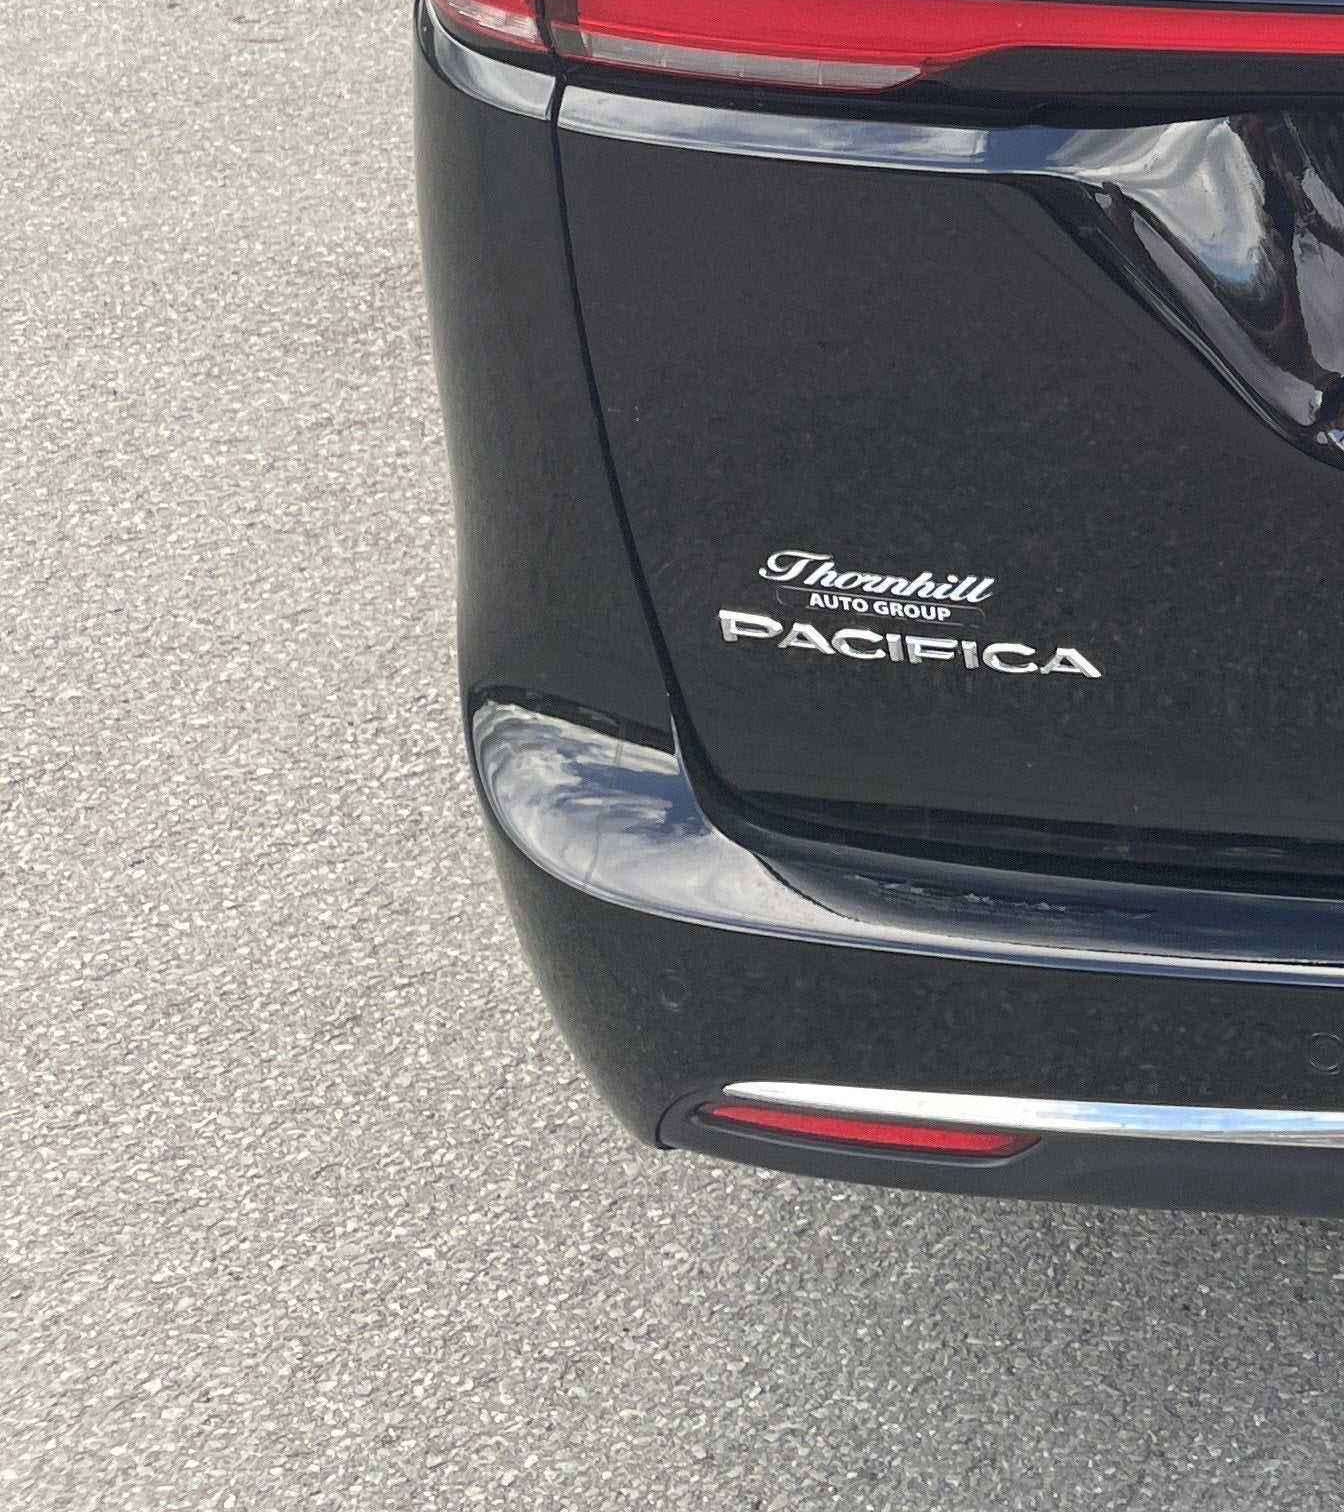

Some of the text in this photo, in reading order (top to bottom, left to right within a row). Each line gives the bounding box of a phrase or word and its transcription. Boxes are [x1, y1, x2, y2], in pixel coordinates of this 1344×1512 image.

[758, 549, 995, 604] Thornhill
[809, 592, 951, 622] AUTO GROUP
[718, 609, 1101, 678] PACIFICA
